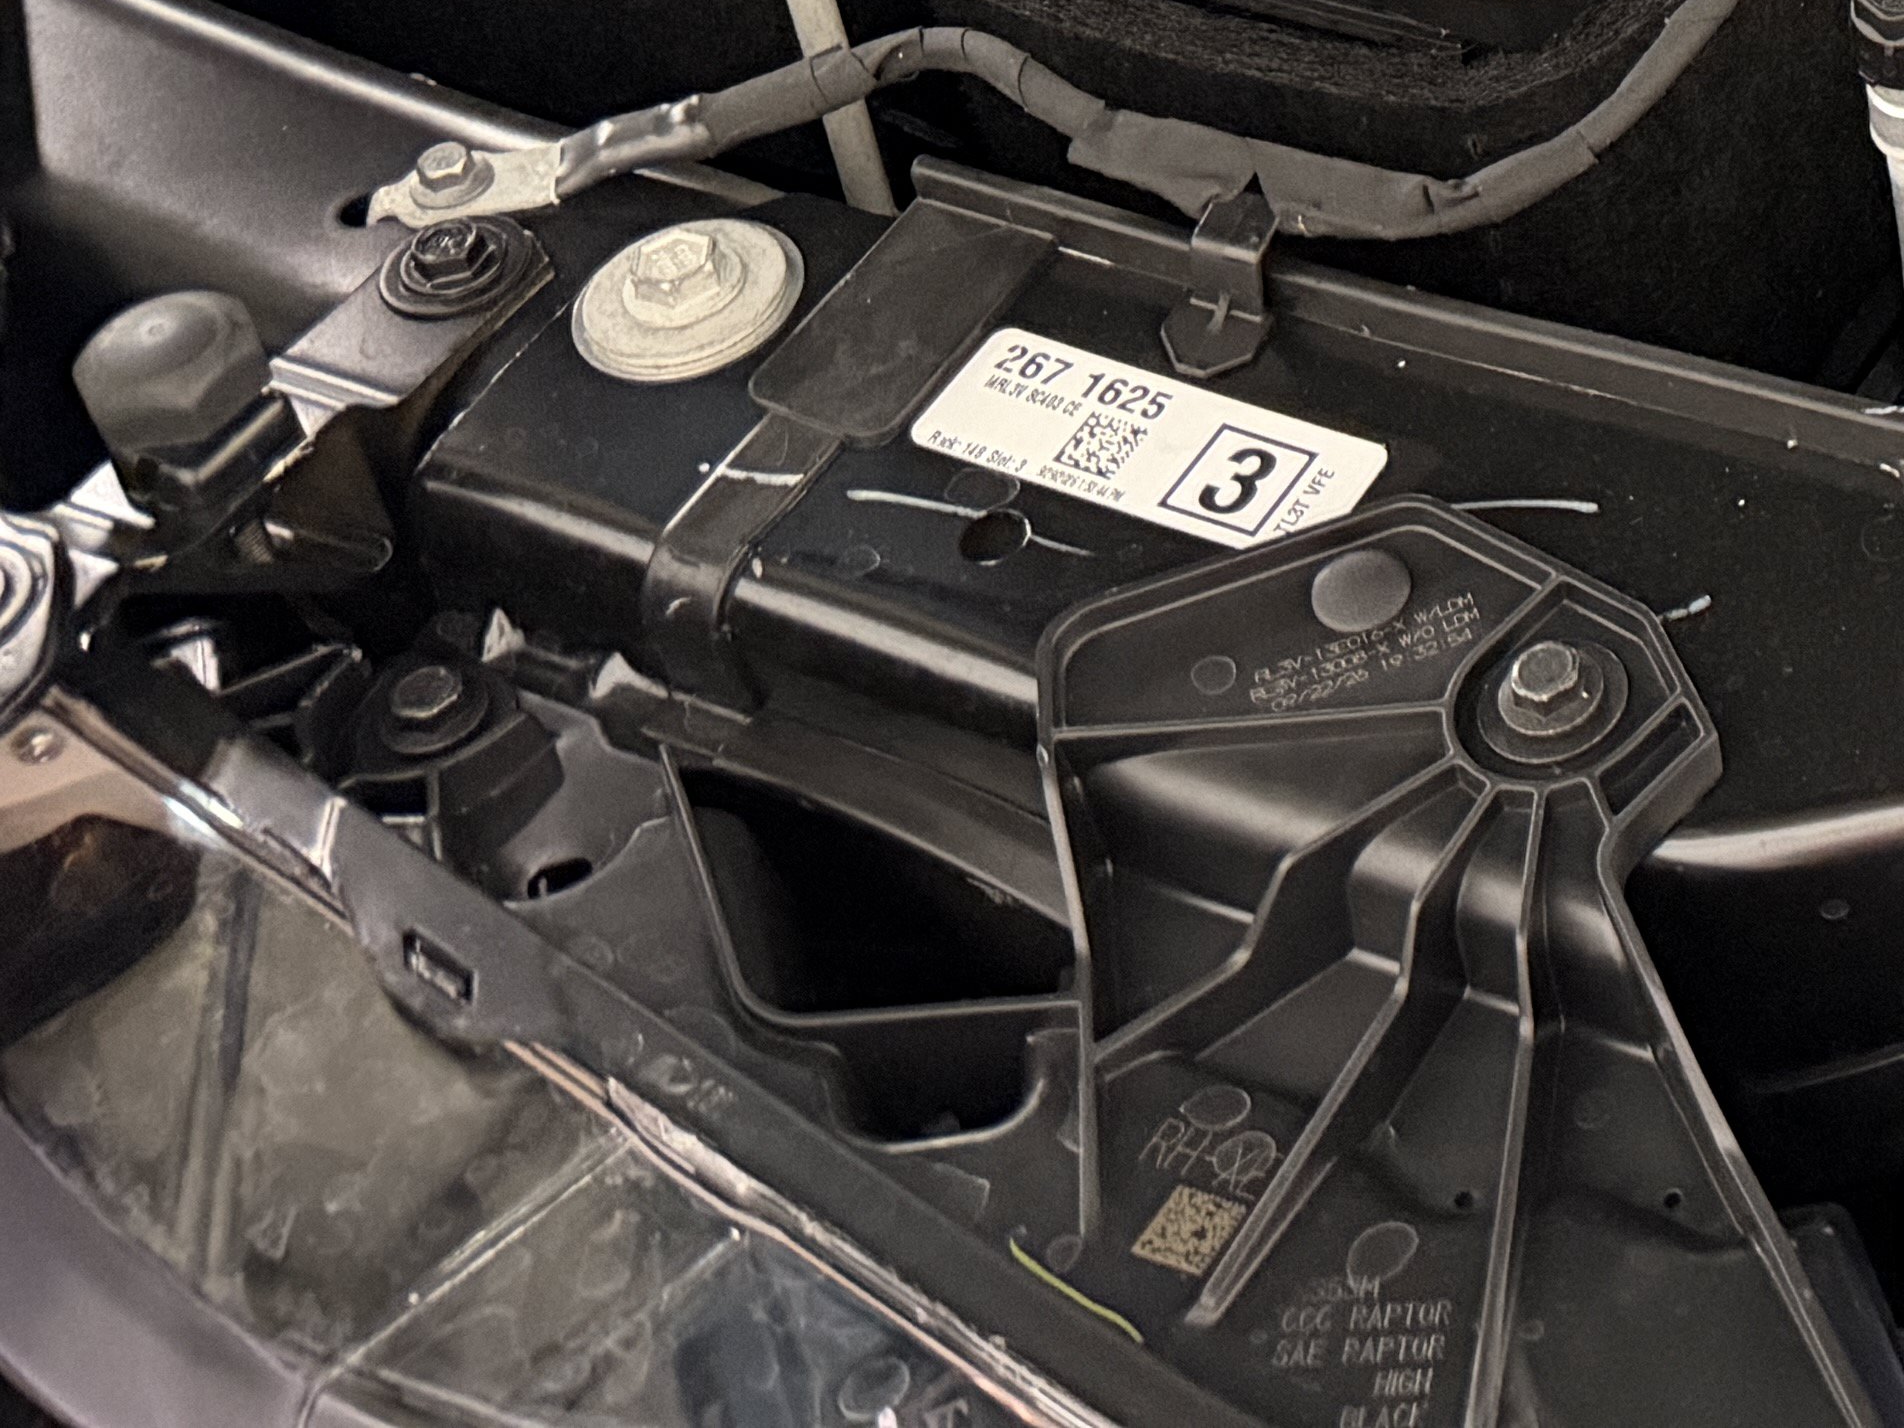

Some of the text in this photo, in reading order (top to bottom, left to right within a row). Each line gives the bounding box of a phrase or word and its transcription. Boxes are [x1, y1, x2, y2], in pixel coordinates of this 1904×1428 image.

[993, 343, 1176, 420] 267 1625
[1199, 447, 1278, 515] 3
[1302, 468, 1338, 495] VFE
[1441, 605, 1480, 630] LDM
[1350, 1300, 1452, 1330] RAPTOR
[1342, 1334, 1446, 1365] RAPTOR
[1373, 1368, 1434, 1395] HIGH
